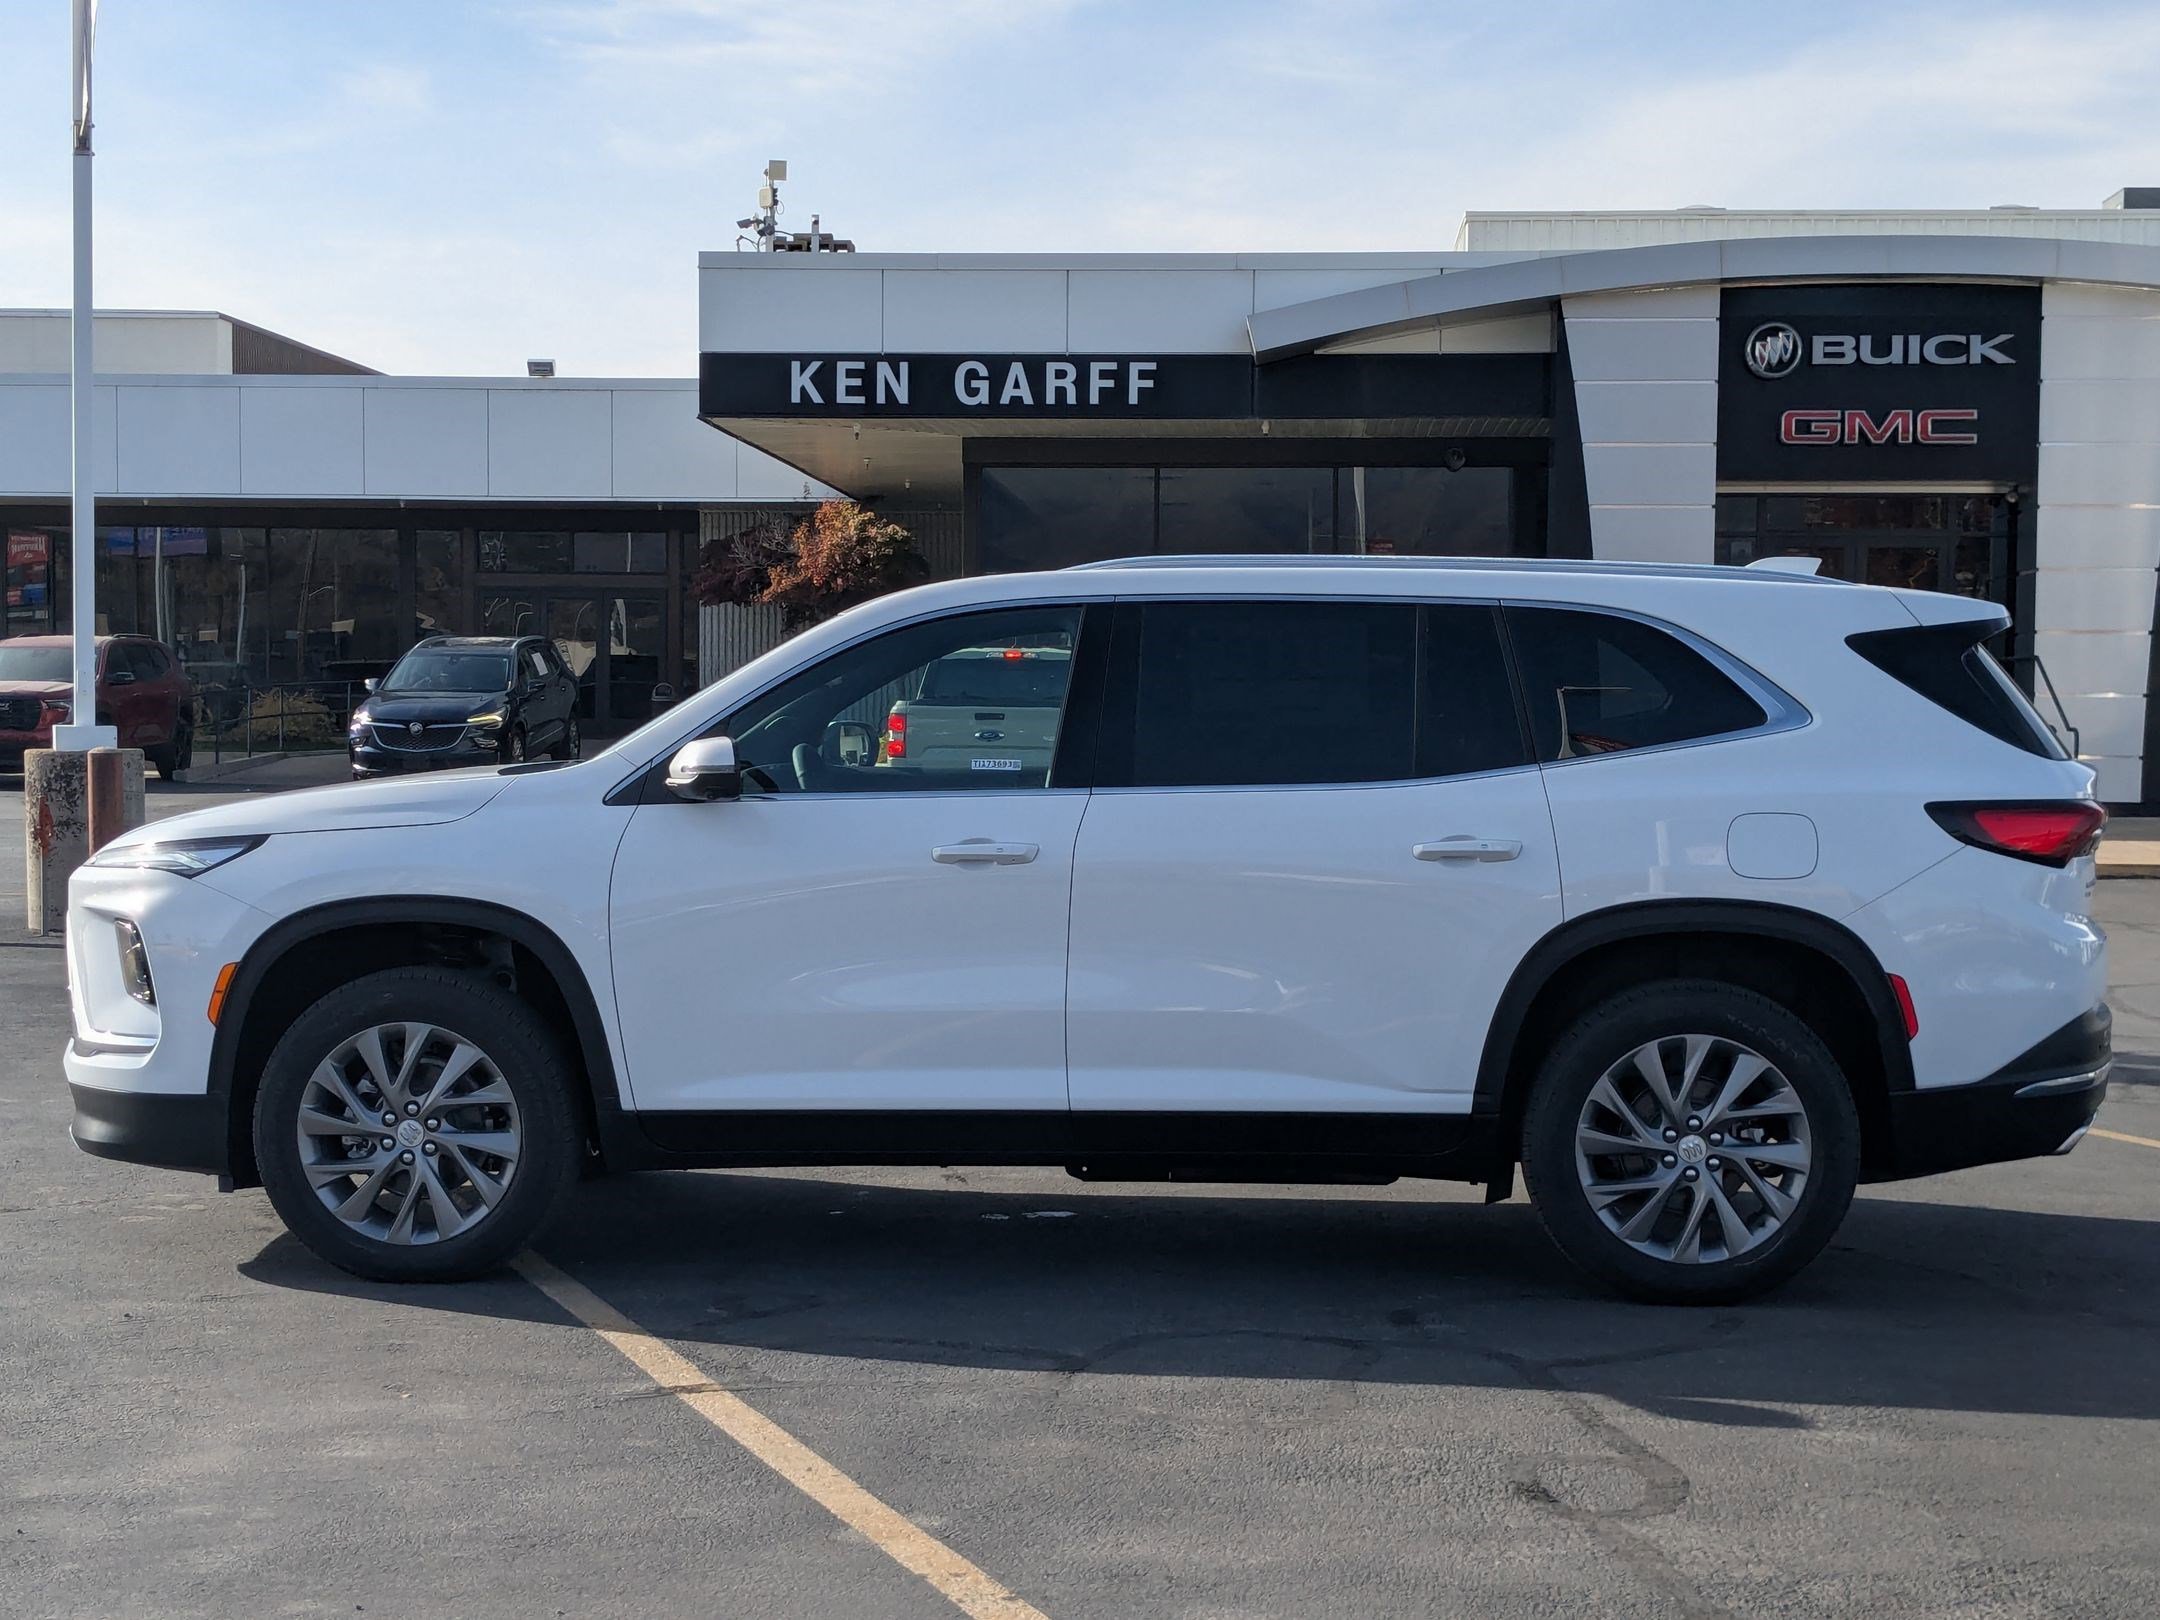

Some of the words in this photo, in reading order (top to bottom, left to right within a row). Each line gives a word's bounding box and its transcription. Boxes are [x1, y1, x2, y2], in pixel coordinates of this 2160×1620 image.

[1811, 333, 2016, 365] BUICK
[790, 360, 909, 405] KEN
[954, 360, 1158, 406] GARFF
[1780, 408, 1978, 445] GMC
